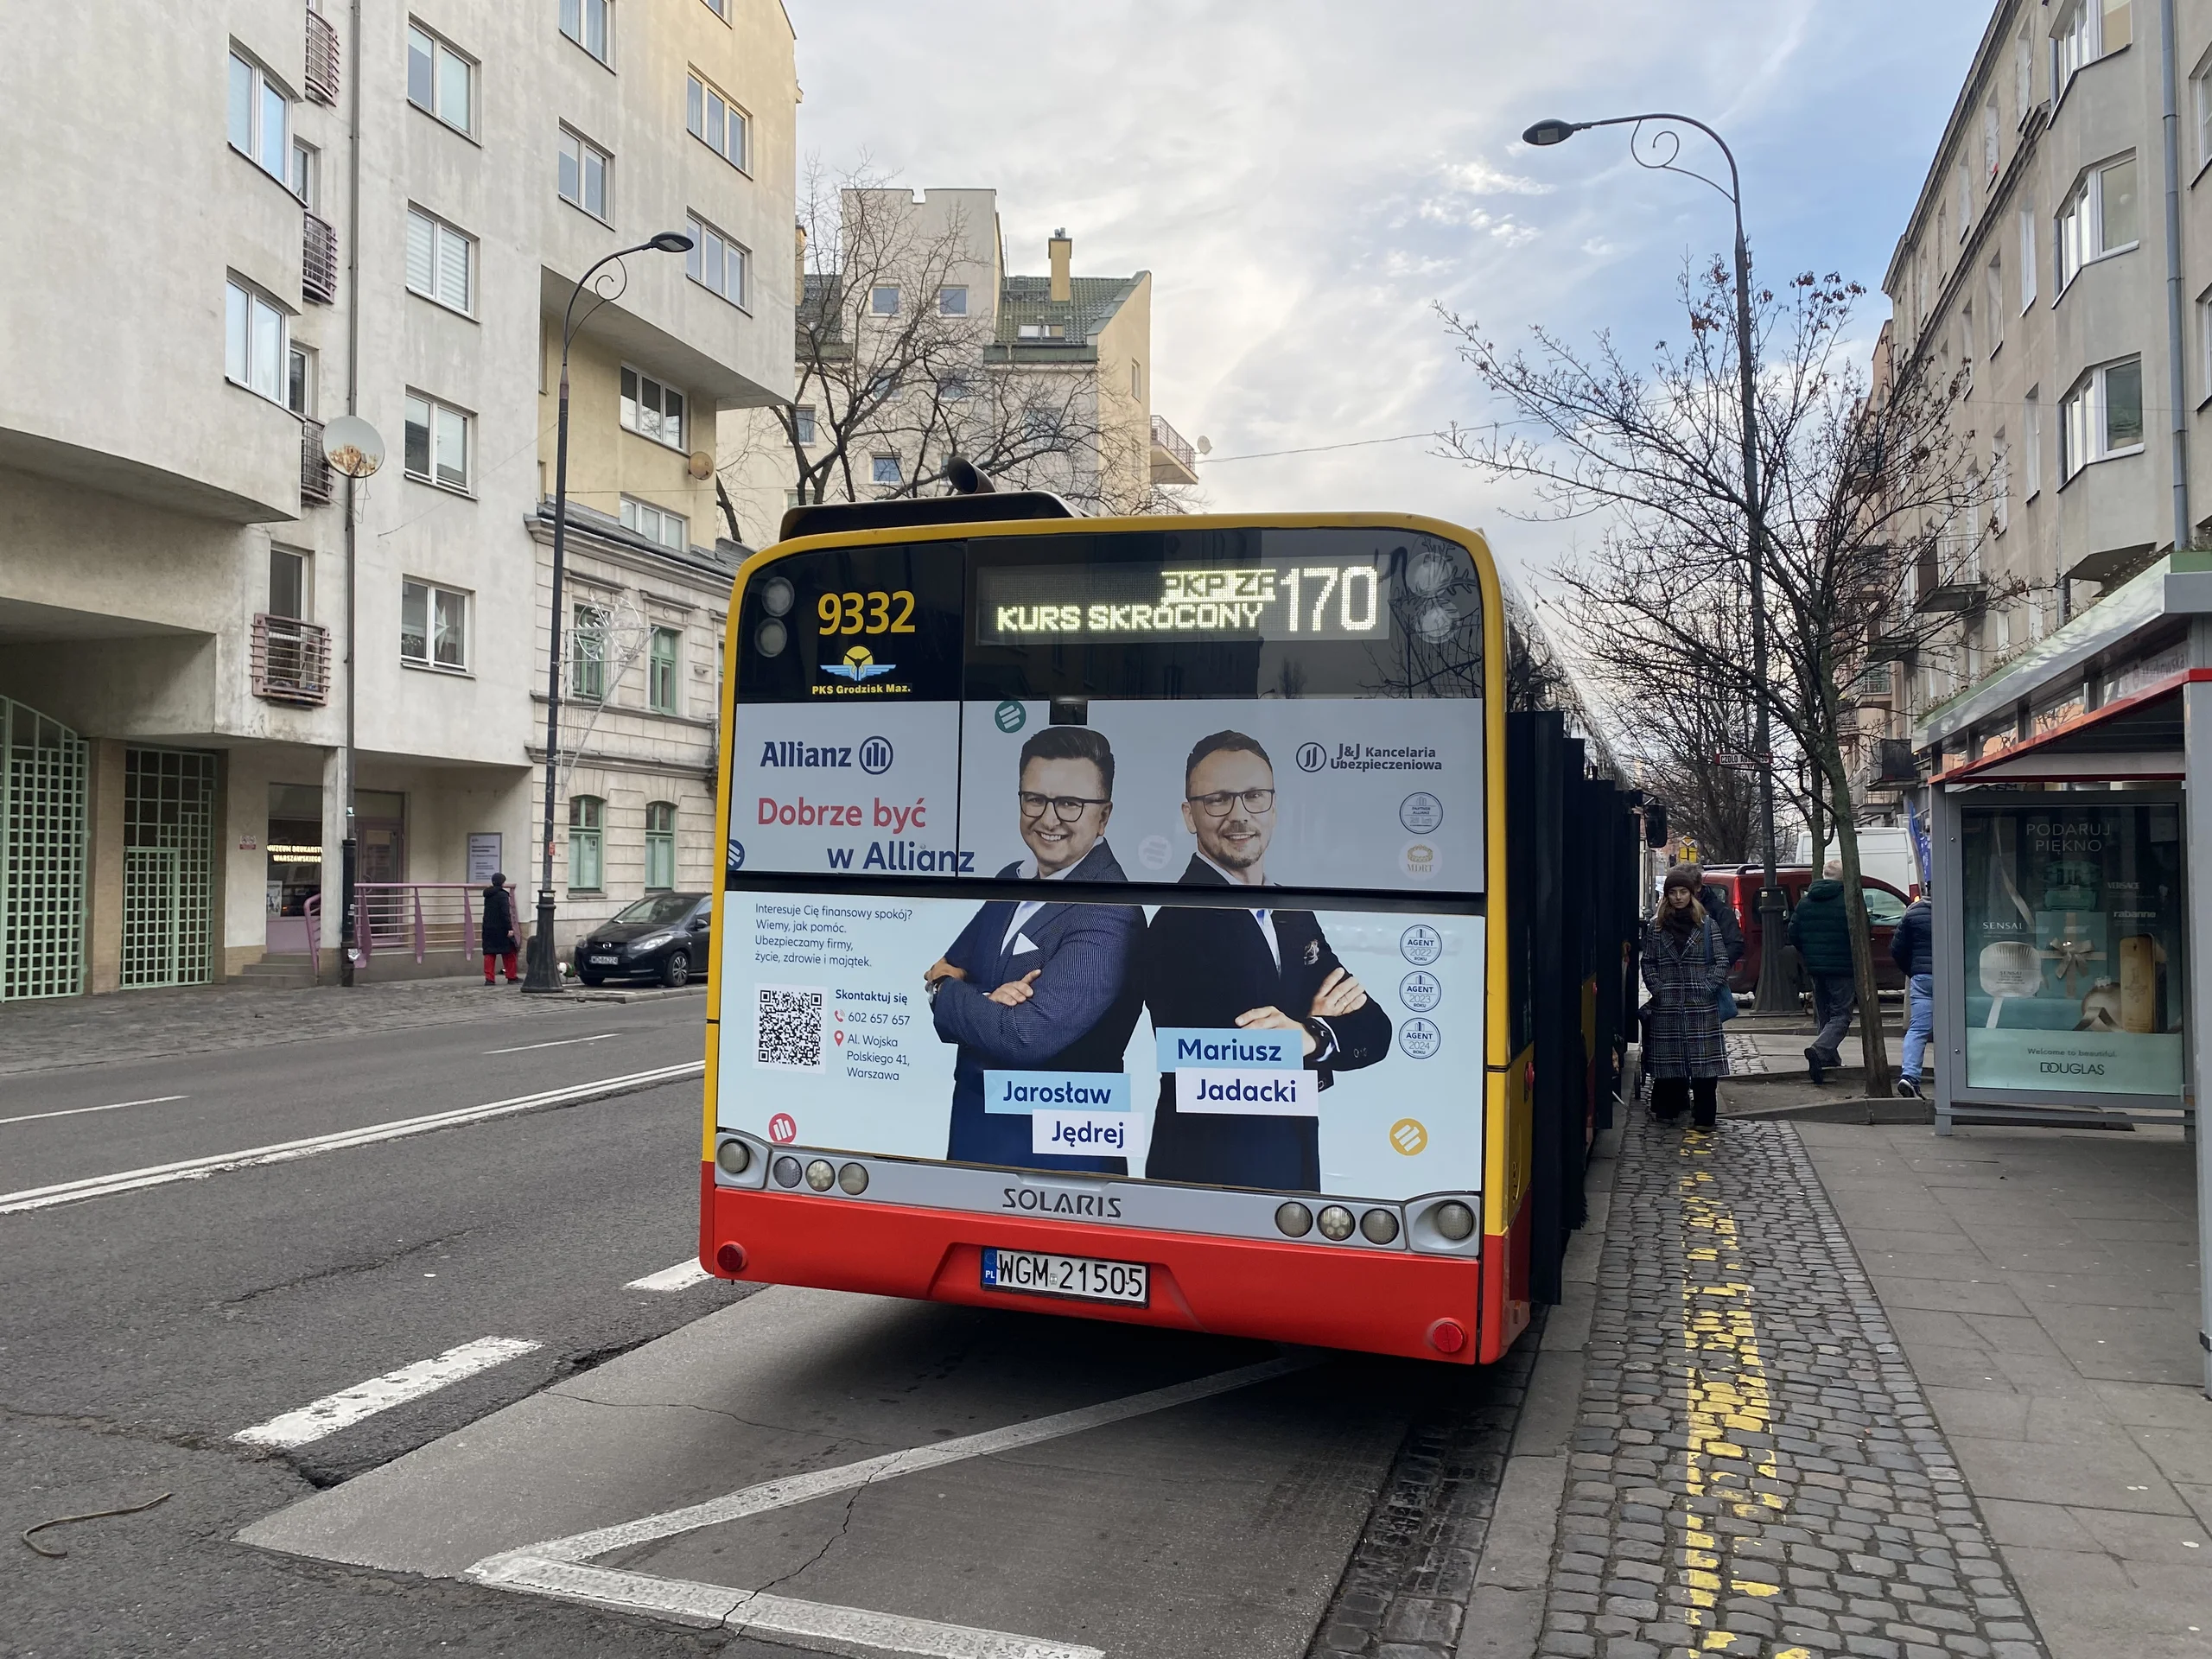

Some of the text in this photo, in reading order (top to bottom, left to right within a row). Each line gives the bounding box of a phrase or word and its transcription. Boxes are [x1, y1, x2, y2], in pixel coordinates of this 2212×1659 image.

[1161, 573, 1227, 598] PKP
[1281, 566, 1377, 632] 170
[817, 590, 916, 635] 9332
[996, 602, 1263, 632] KURS SKRÓCONY
[812, 683, 912, 695] PKS Grodzisk Maz.
[760, 741, 852, 767] Allianz
[1337, 743, 1436, 760] J&J Kancelaria
[1331, 758, 1442, 772] Ubezpieczeniowa
[758, 797, 926, 834] Dobrze być
[2026, 823, 2111, 836] PODARUJ
[2036, 840, 2102, 855] PIĘKNO
[827, 841, 975, 872] w Allianz
[1407, 863, 1433, 873] MDRT
[755, 903, 913, 921] Interesuje Cię finansowy spokój?
[756, 919, 847, 934] Wiemy, jak pomóc.
[1982, 921, 2023, 930] SENSAI
[755, 935, 854, 951] Ubezpieczamy firmy,
[1407, 938, 1434, 947] AGENT
[754, 950, 780, 963] życie,
[783, 952, 821, 964] zdrowie
[830, 956, 872, 969] majątek.
[1410, 948, 1432, 957] 2022
[836, 988, 908, 1006] Skontaktuj się
[1407, 985, 1433, 994] AGENT
[1409, 994, 1431, 1003] 2023
[848, 1012, 911, 1026] 602 657 657
[847, 1033, 899, 1048] Al. Wojska
[1406, 1032, 1433, 1040] AGENT
[1177, 1038, 1282, 1062] Mariusz
[1408, 1040, 1430, 1051] 2024
[2027, 1047, 2065, 1056] Welcome
[847, 1050, 910, 1067] Polskiego 41,
[847, 1067, 899, 1081] Warszawa
[2040, 1062, 2105, 1076] DOUGLAS
[1003, 1080, 1111, 1105] Jarosław
[1196, 1078, 1297, 1103] Jadacki
[1052, 1120, 1124, 1149] Jędrej
[1002, 1188, 1122, 1218] SOLARIS
[985, 1270, 995, 1279] PL
[999, 1254, 1142, 1297] WGM 21505
